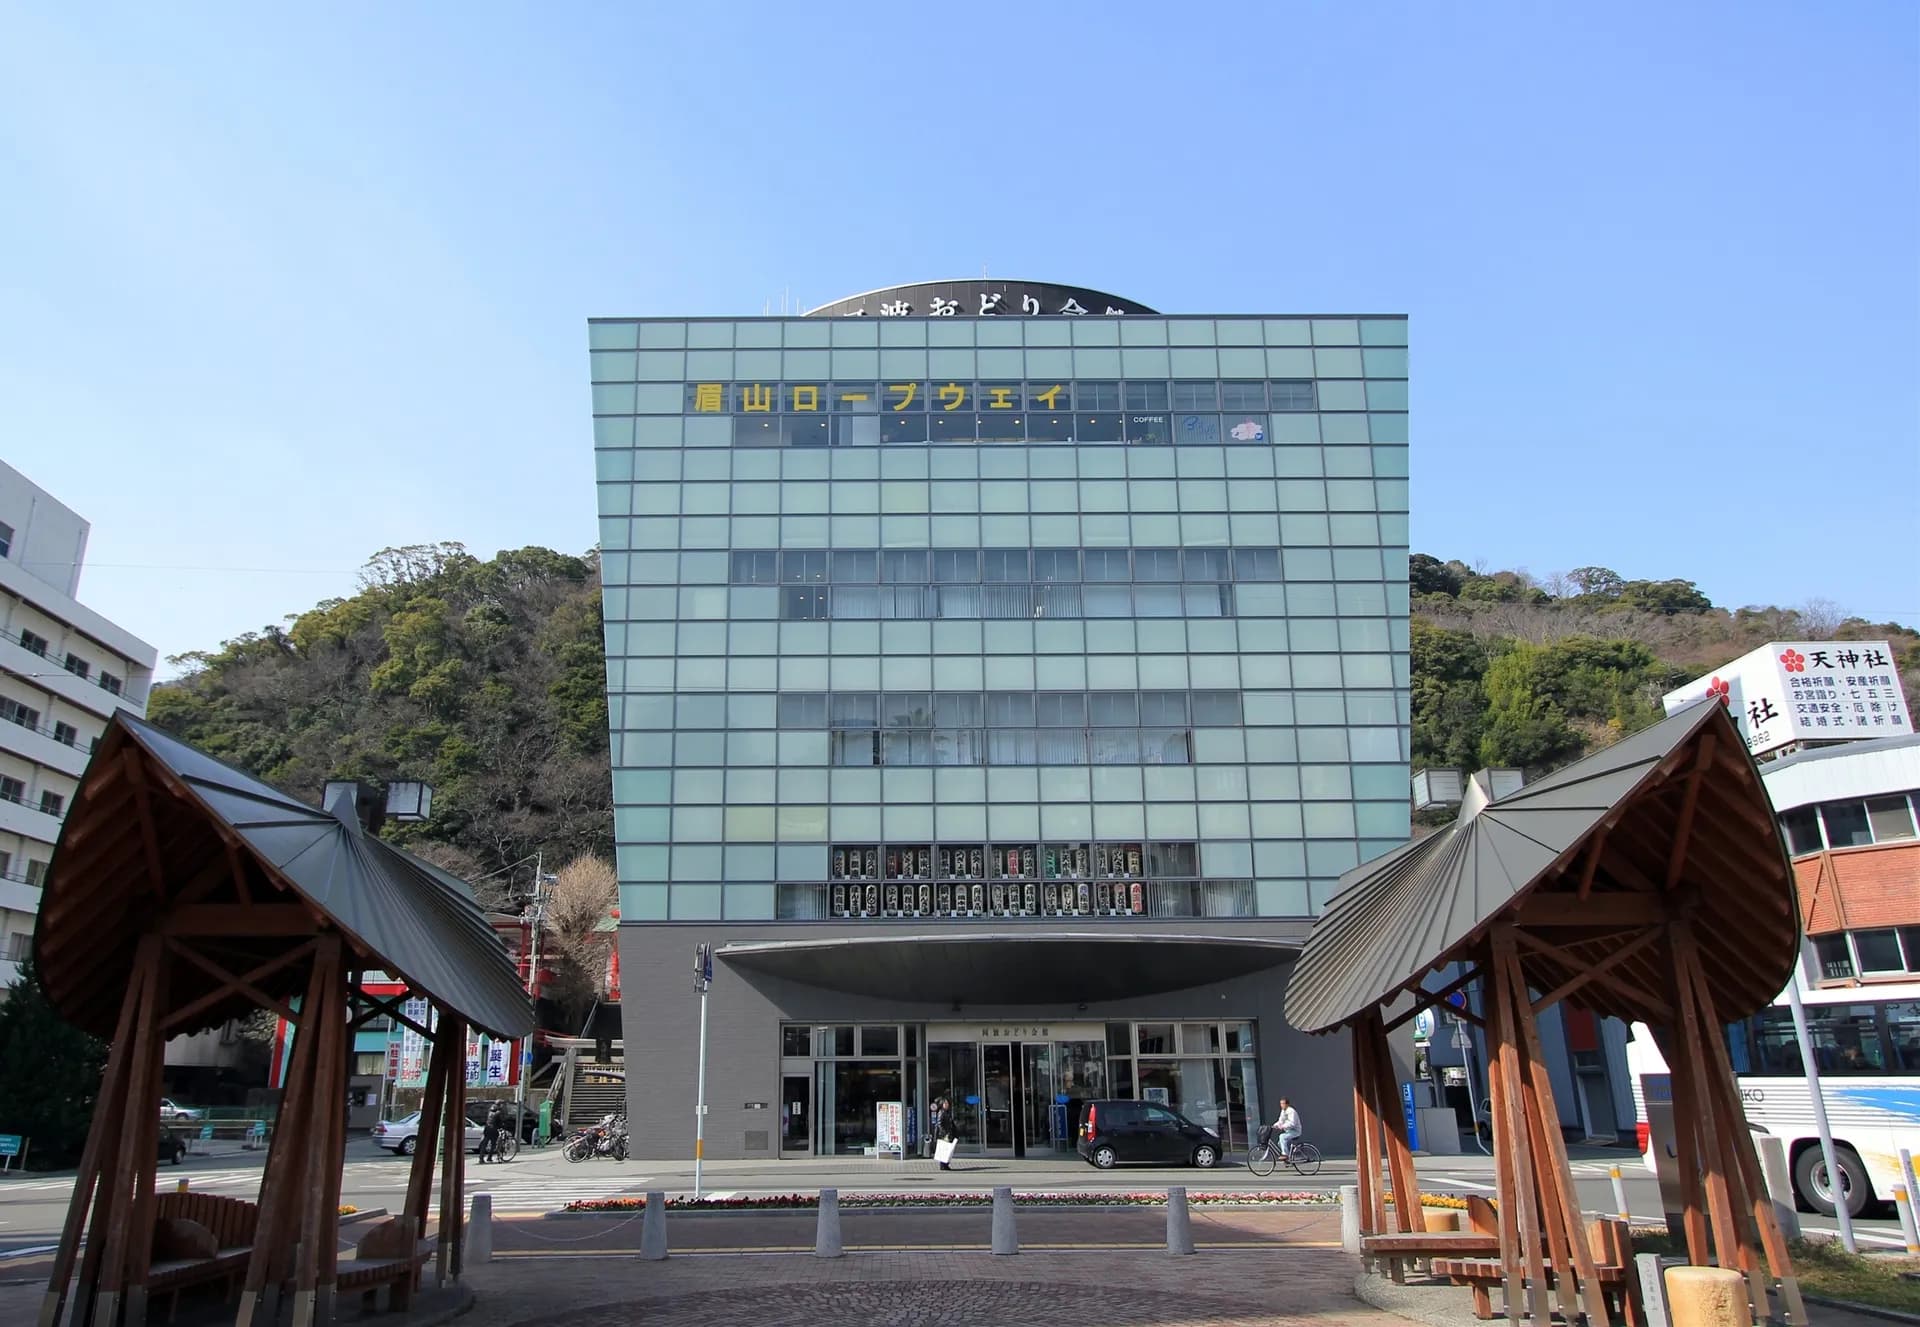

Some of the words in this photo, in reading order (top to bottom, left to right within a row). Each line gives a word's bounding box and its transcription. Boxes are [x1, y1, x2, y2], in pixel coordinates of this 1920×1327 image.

[844, 293, 1125, 316] 波おどり会
[1809, 649, 1889, 669] 天神社
